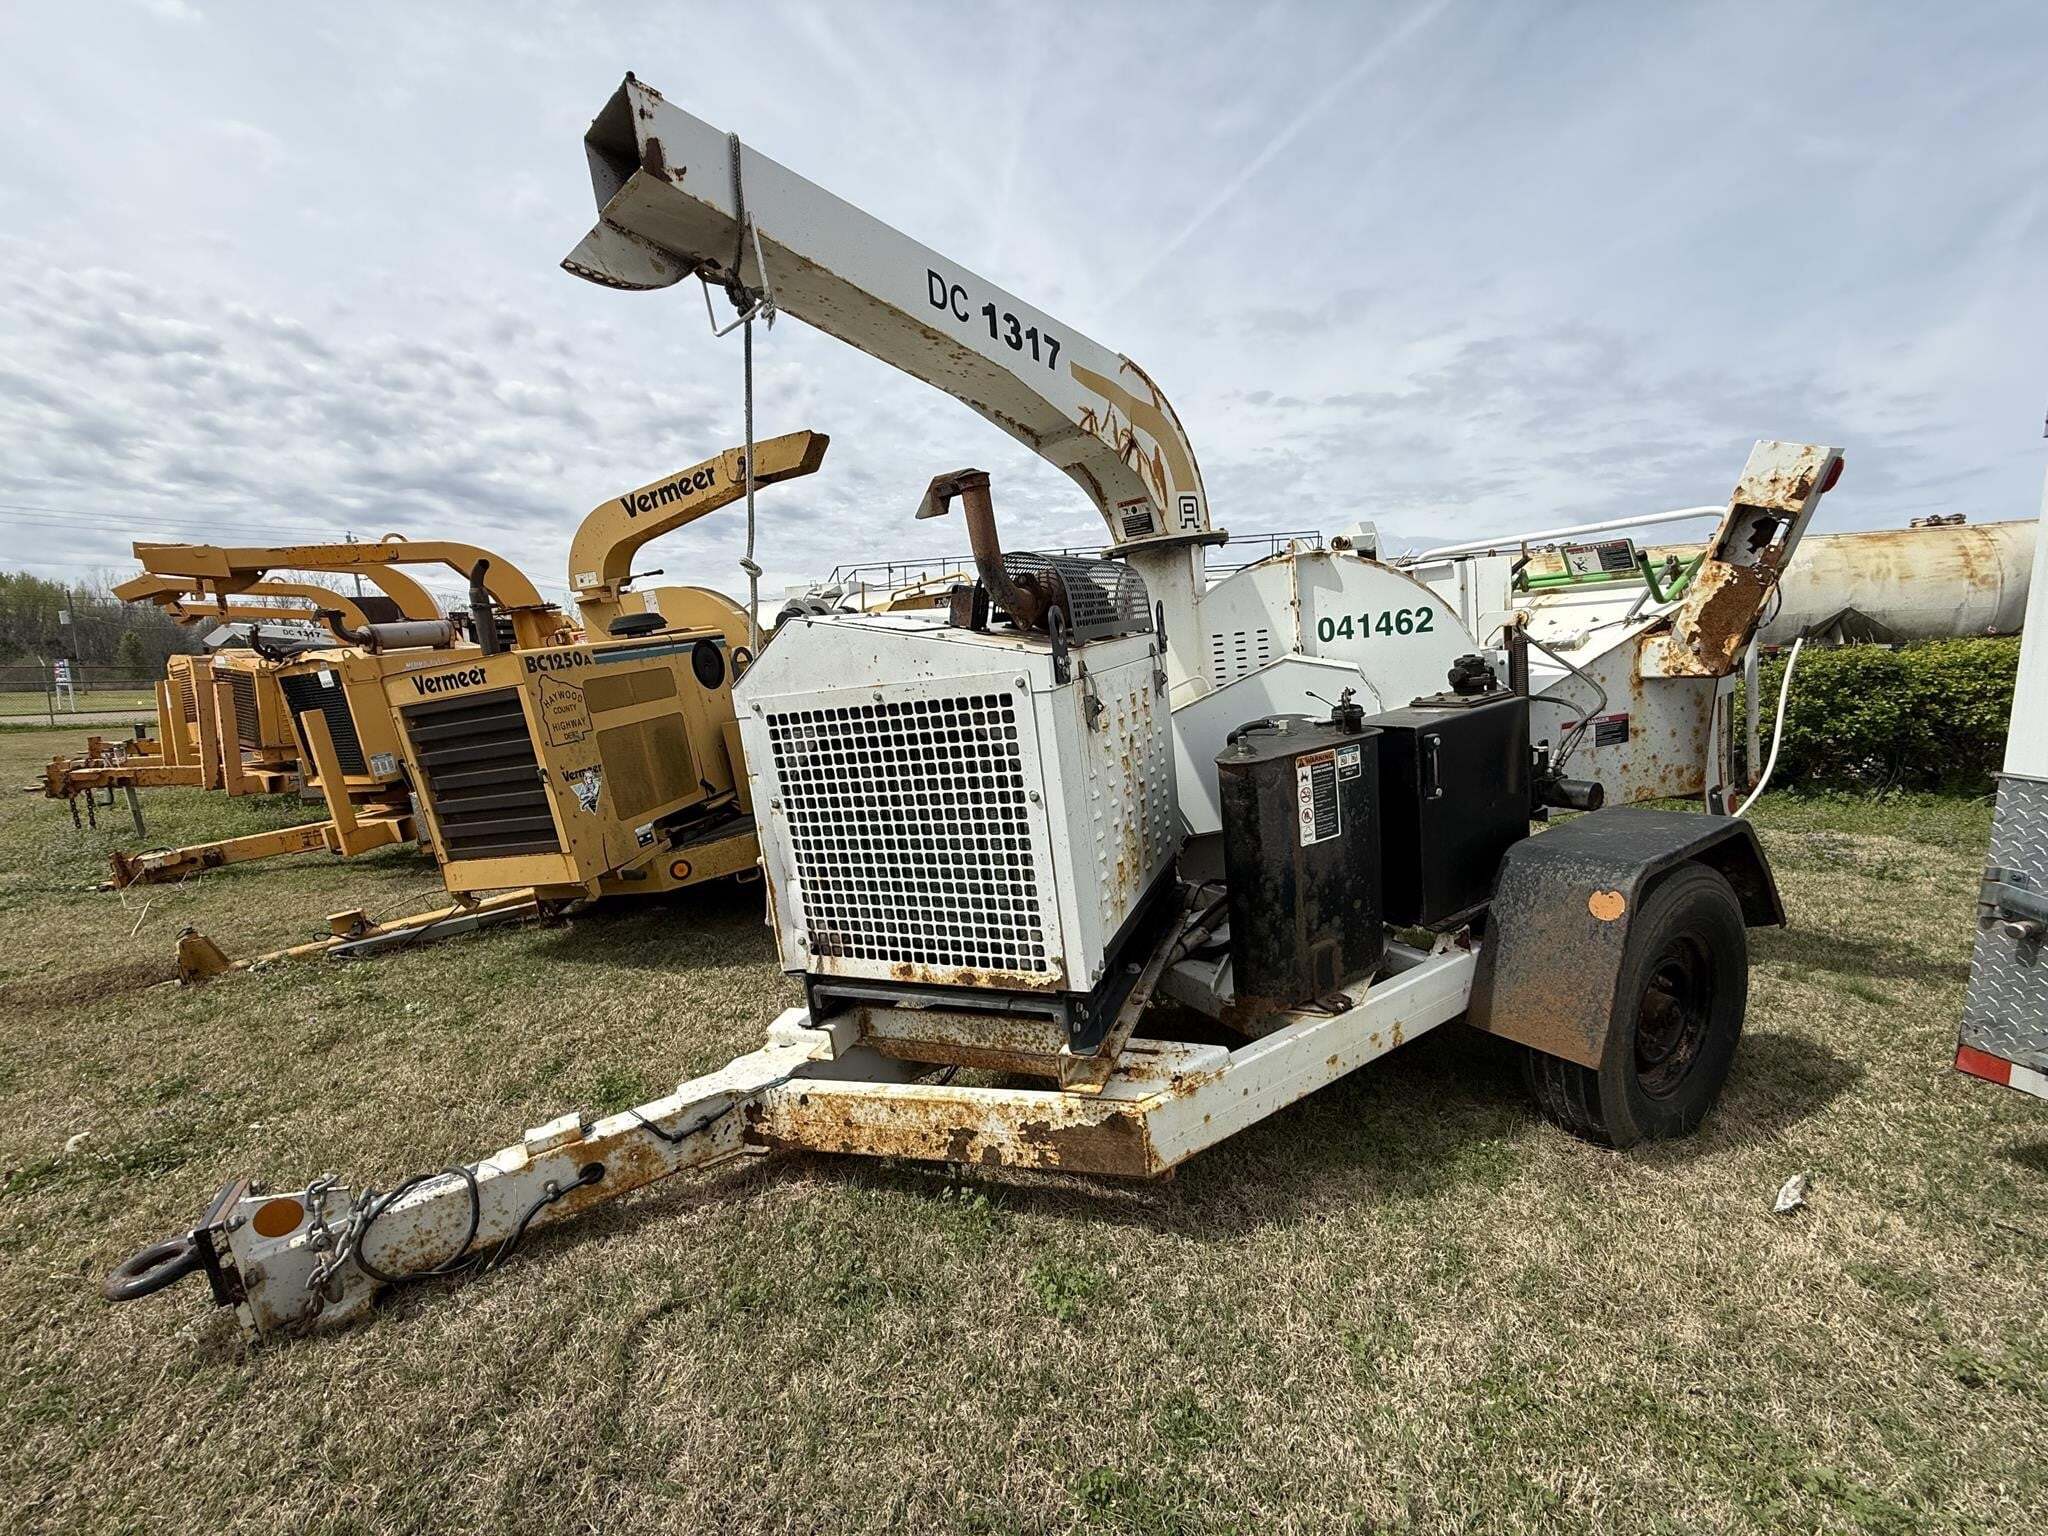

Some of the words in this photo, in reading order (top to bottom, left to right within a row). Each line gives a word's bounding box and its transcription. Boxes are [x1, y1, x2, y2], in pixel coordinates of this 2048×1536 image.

[926, 268, 970, 323] DC
[981, 302, 1061, 371] 1317
[620, 466, 716, 519] Vermeer
[282, 628, 295, 636] DC
[1317, 606, 1434, 643] 041462
[524, 651, 593, 674] BC1250A
[411, 667, 488, 696] Vermeer
[543, 690, 583, 708] HAYWOOD
[553, 704, 577, 715] COUNTY
[552, 717, 585, 731] HIGHWAY
